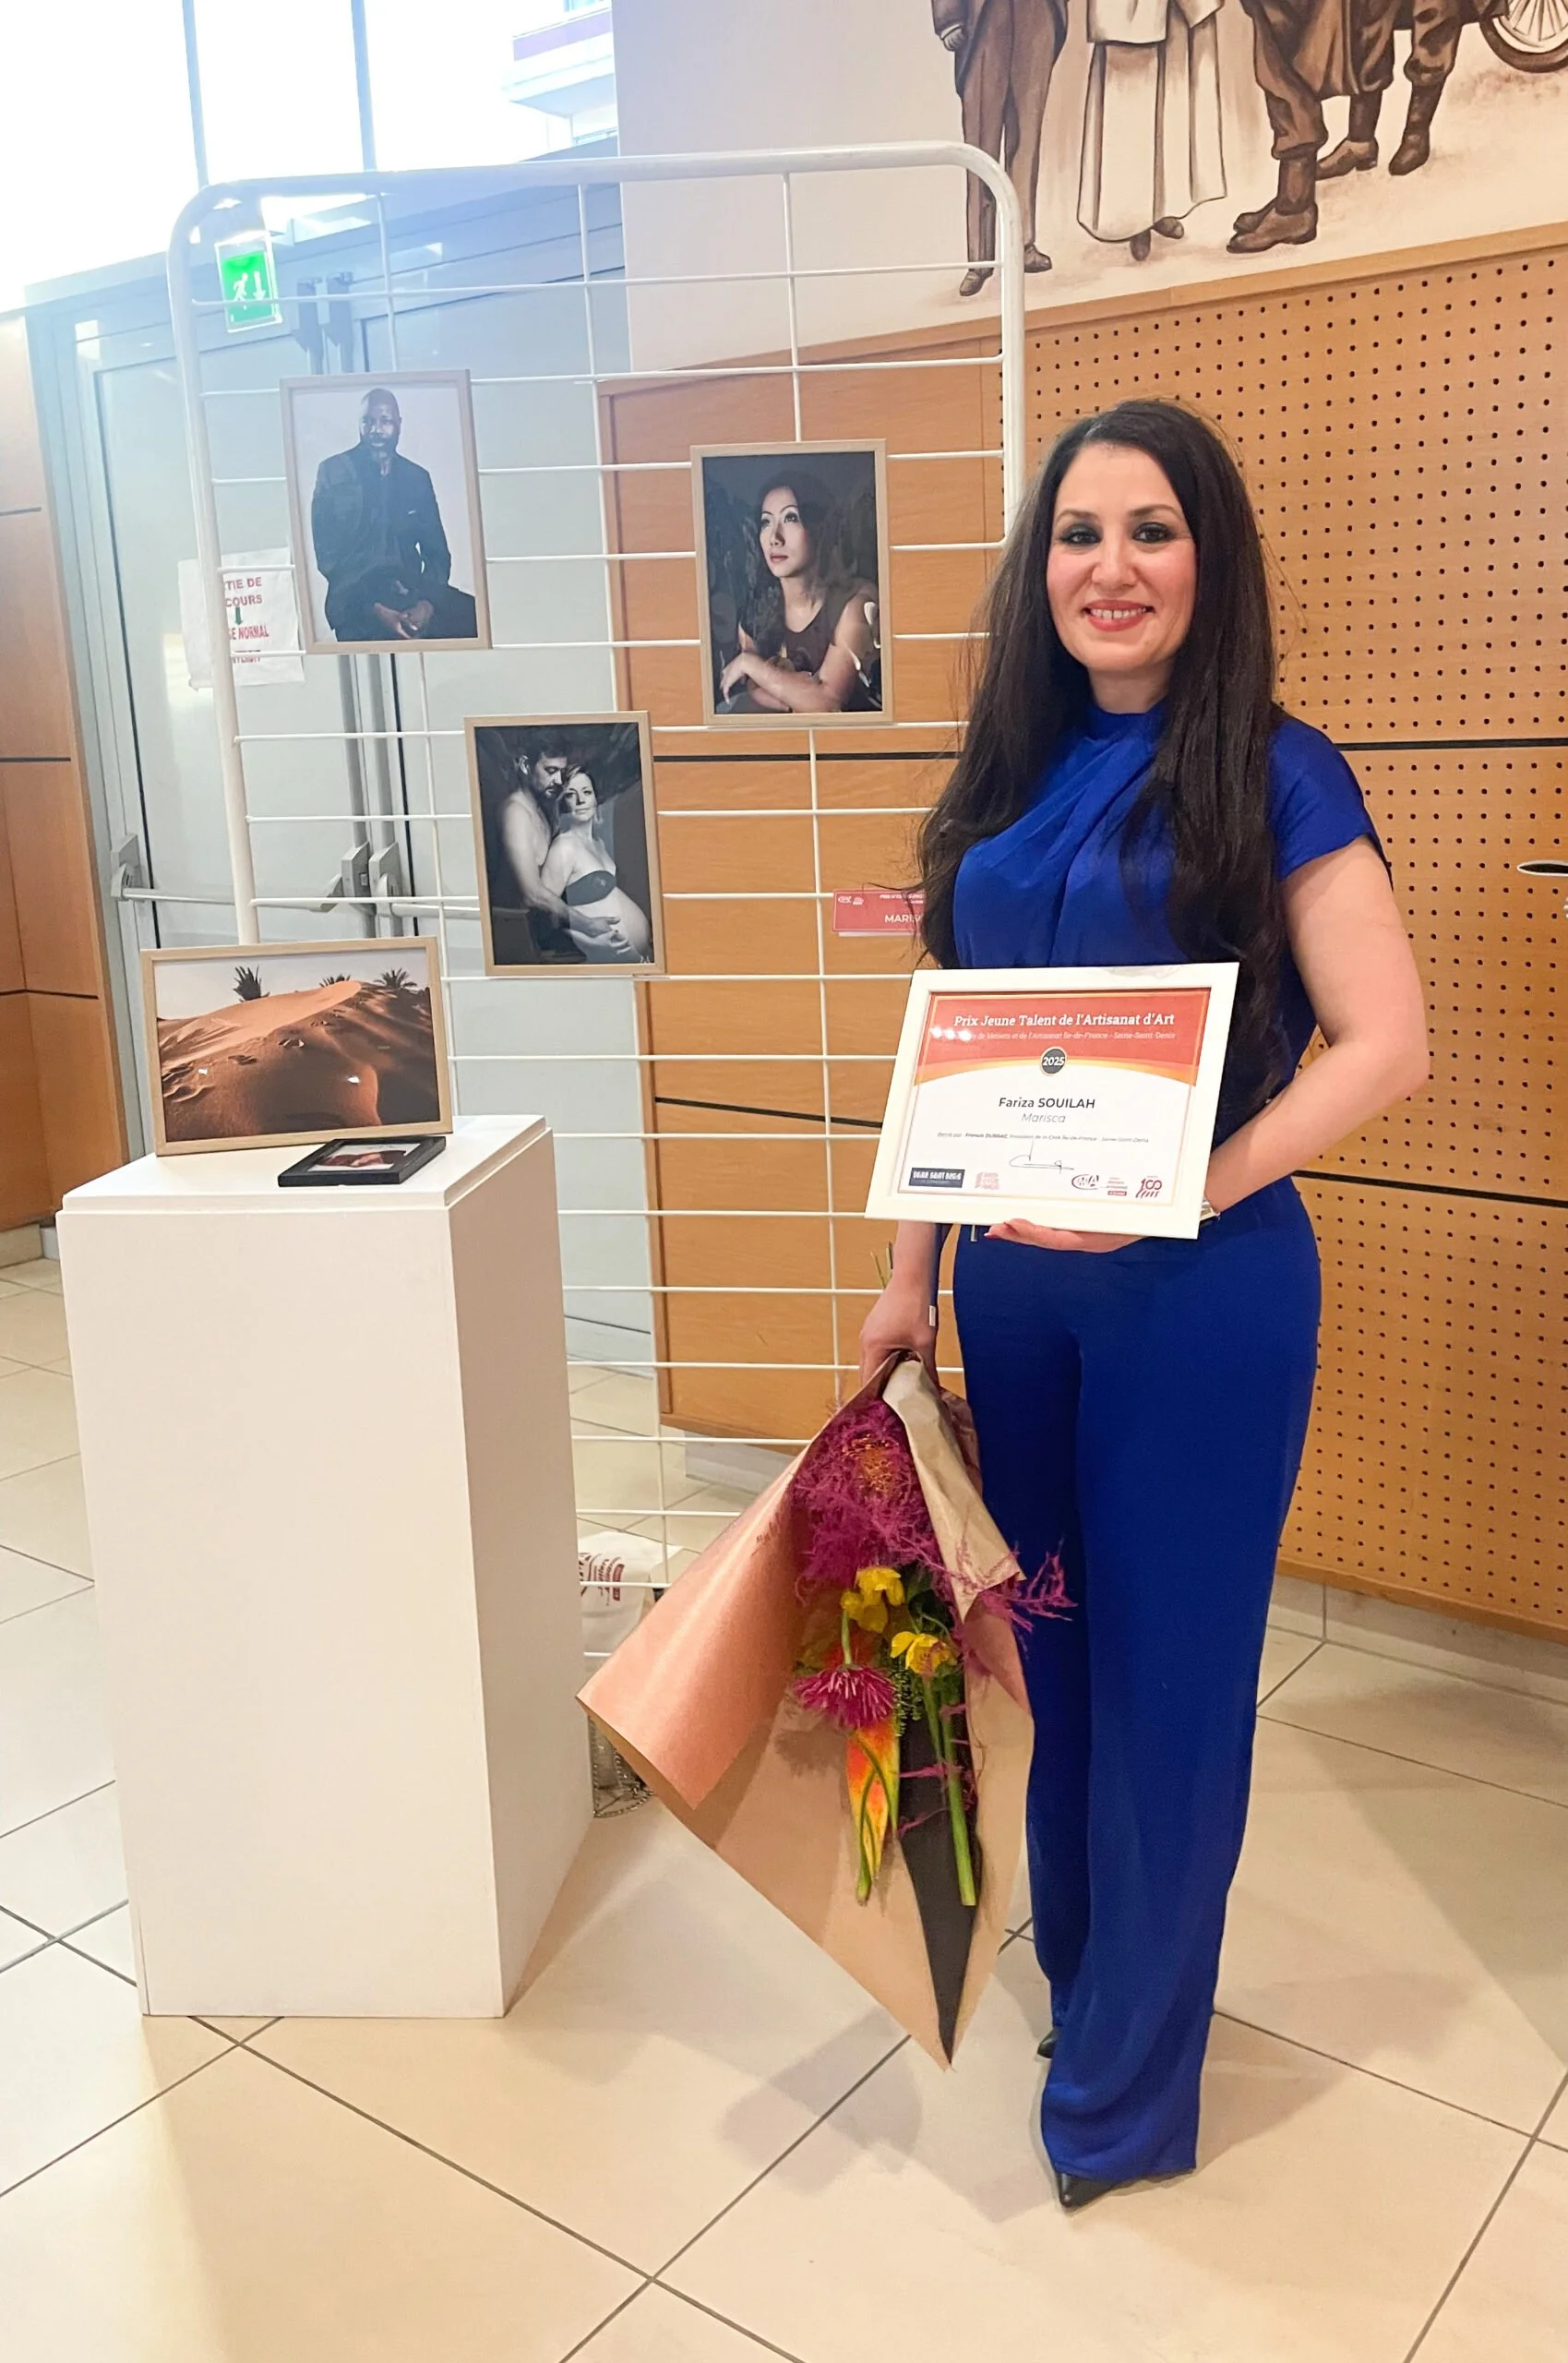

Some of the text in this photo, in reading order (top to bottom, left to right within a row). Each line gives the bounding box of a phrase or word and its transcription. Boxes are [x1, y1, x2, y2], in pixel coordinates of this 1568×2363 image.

[223, 577, 262, 591] TIE DE
[238, 625, 269, 641] NORMAL
[953, 1012, 1175, 1027] Prix Jeune Talent de l'Artisanat d'Art
[1043, 1056, 1065, 1066] 2025
[999, 1097, 1096, 1109] Fariza SOUILAH
[1021, 1112, 1066, 1123] Marisca
